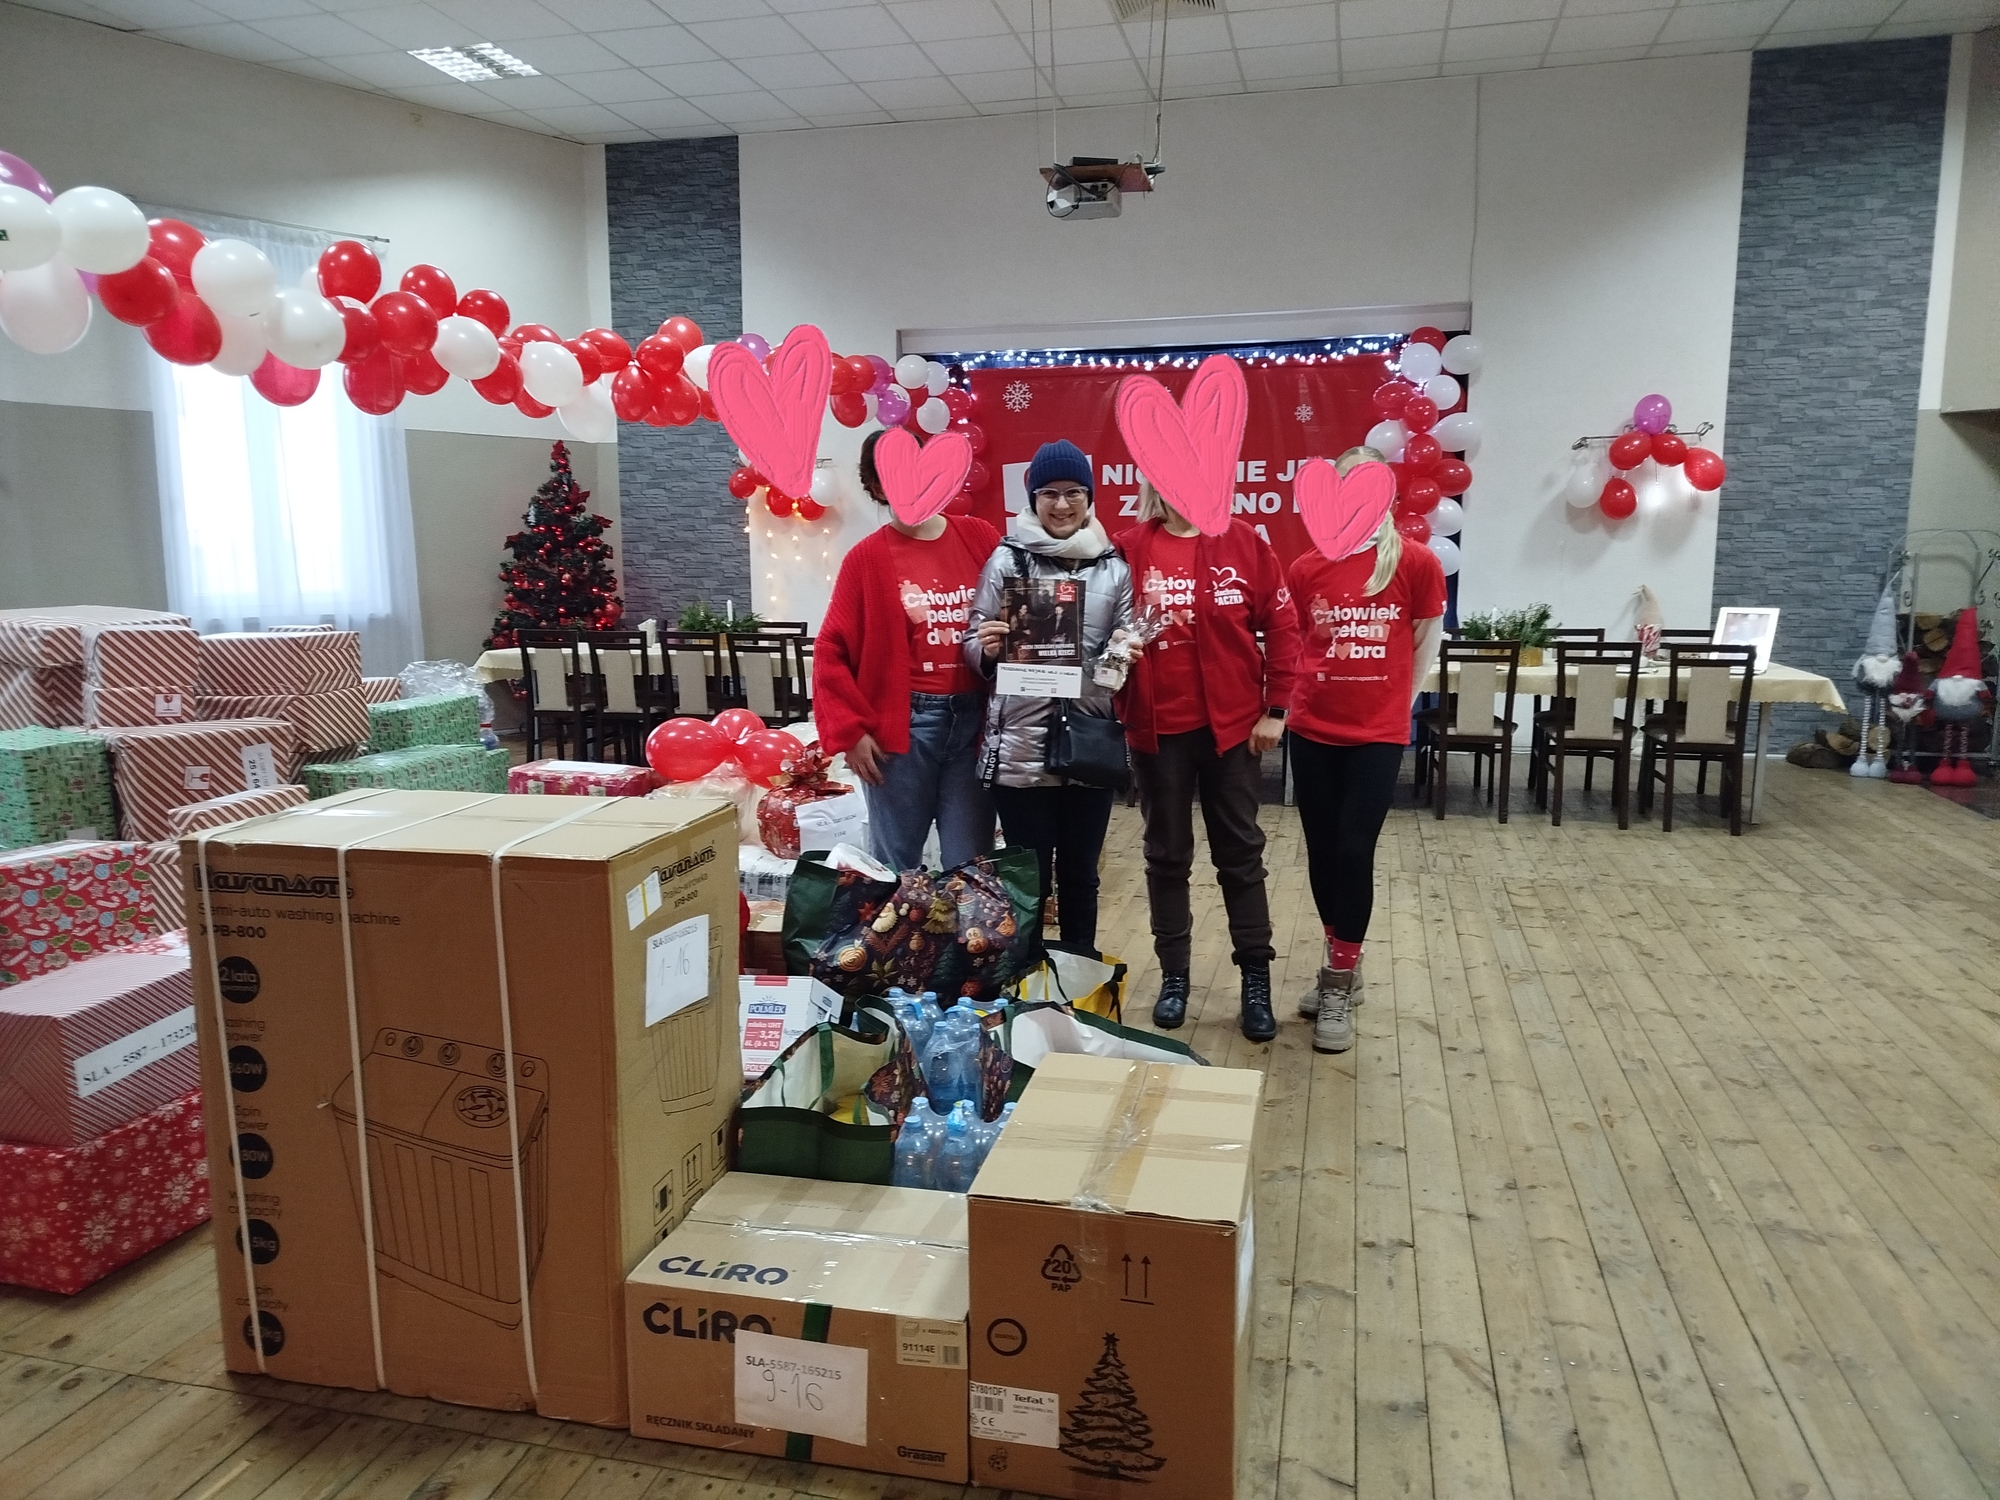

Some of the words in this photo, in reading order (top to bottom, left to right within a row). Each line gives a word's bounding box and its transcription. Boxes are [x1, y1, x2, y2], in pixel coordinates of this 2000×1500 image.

[1236, 460, 1267, 483] IE
[904, 585, 977, 608] Człowie
[275, 906, 334, 925] washing
[750, 1005, 785, 1014] POLMLEK
[226, 1018, 266, 1032] ashing
[759, 1030, 780, 1040] 3,2%
[83, 1066, 112, 1086] SLA
[236, 1121, 269, 1131] ower
[1051, 1259, 1072, 1275] 20
[1051, 1282, 1072, 1293] PAP
[902, 1342, 936, 1354] 91114E
[745, 1355, 842, 1381] SLA-5587-165215
[762, 1369, 824, 1411] 9-16
[1012, 1393, 1044, 1405] Tefal
[646, 1414, 693, 1430] RĘCZNIK
[695, 1421, 756, 1439] SKŁADANY
